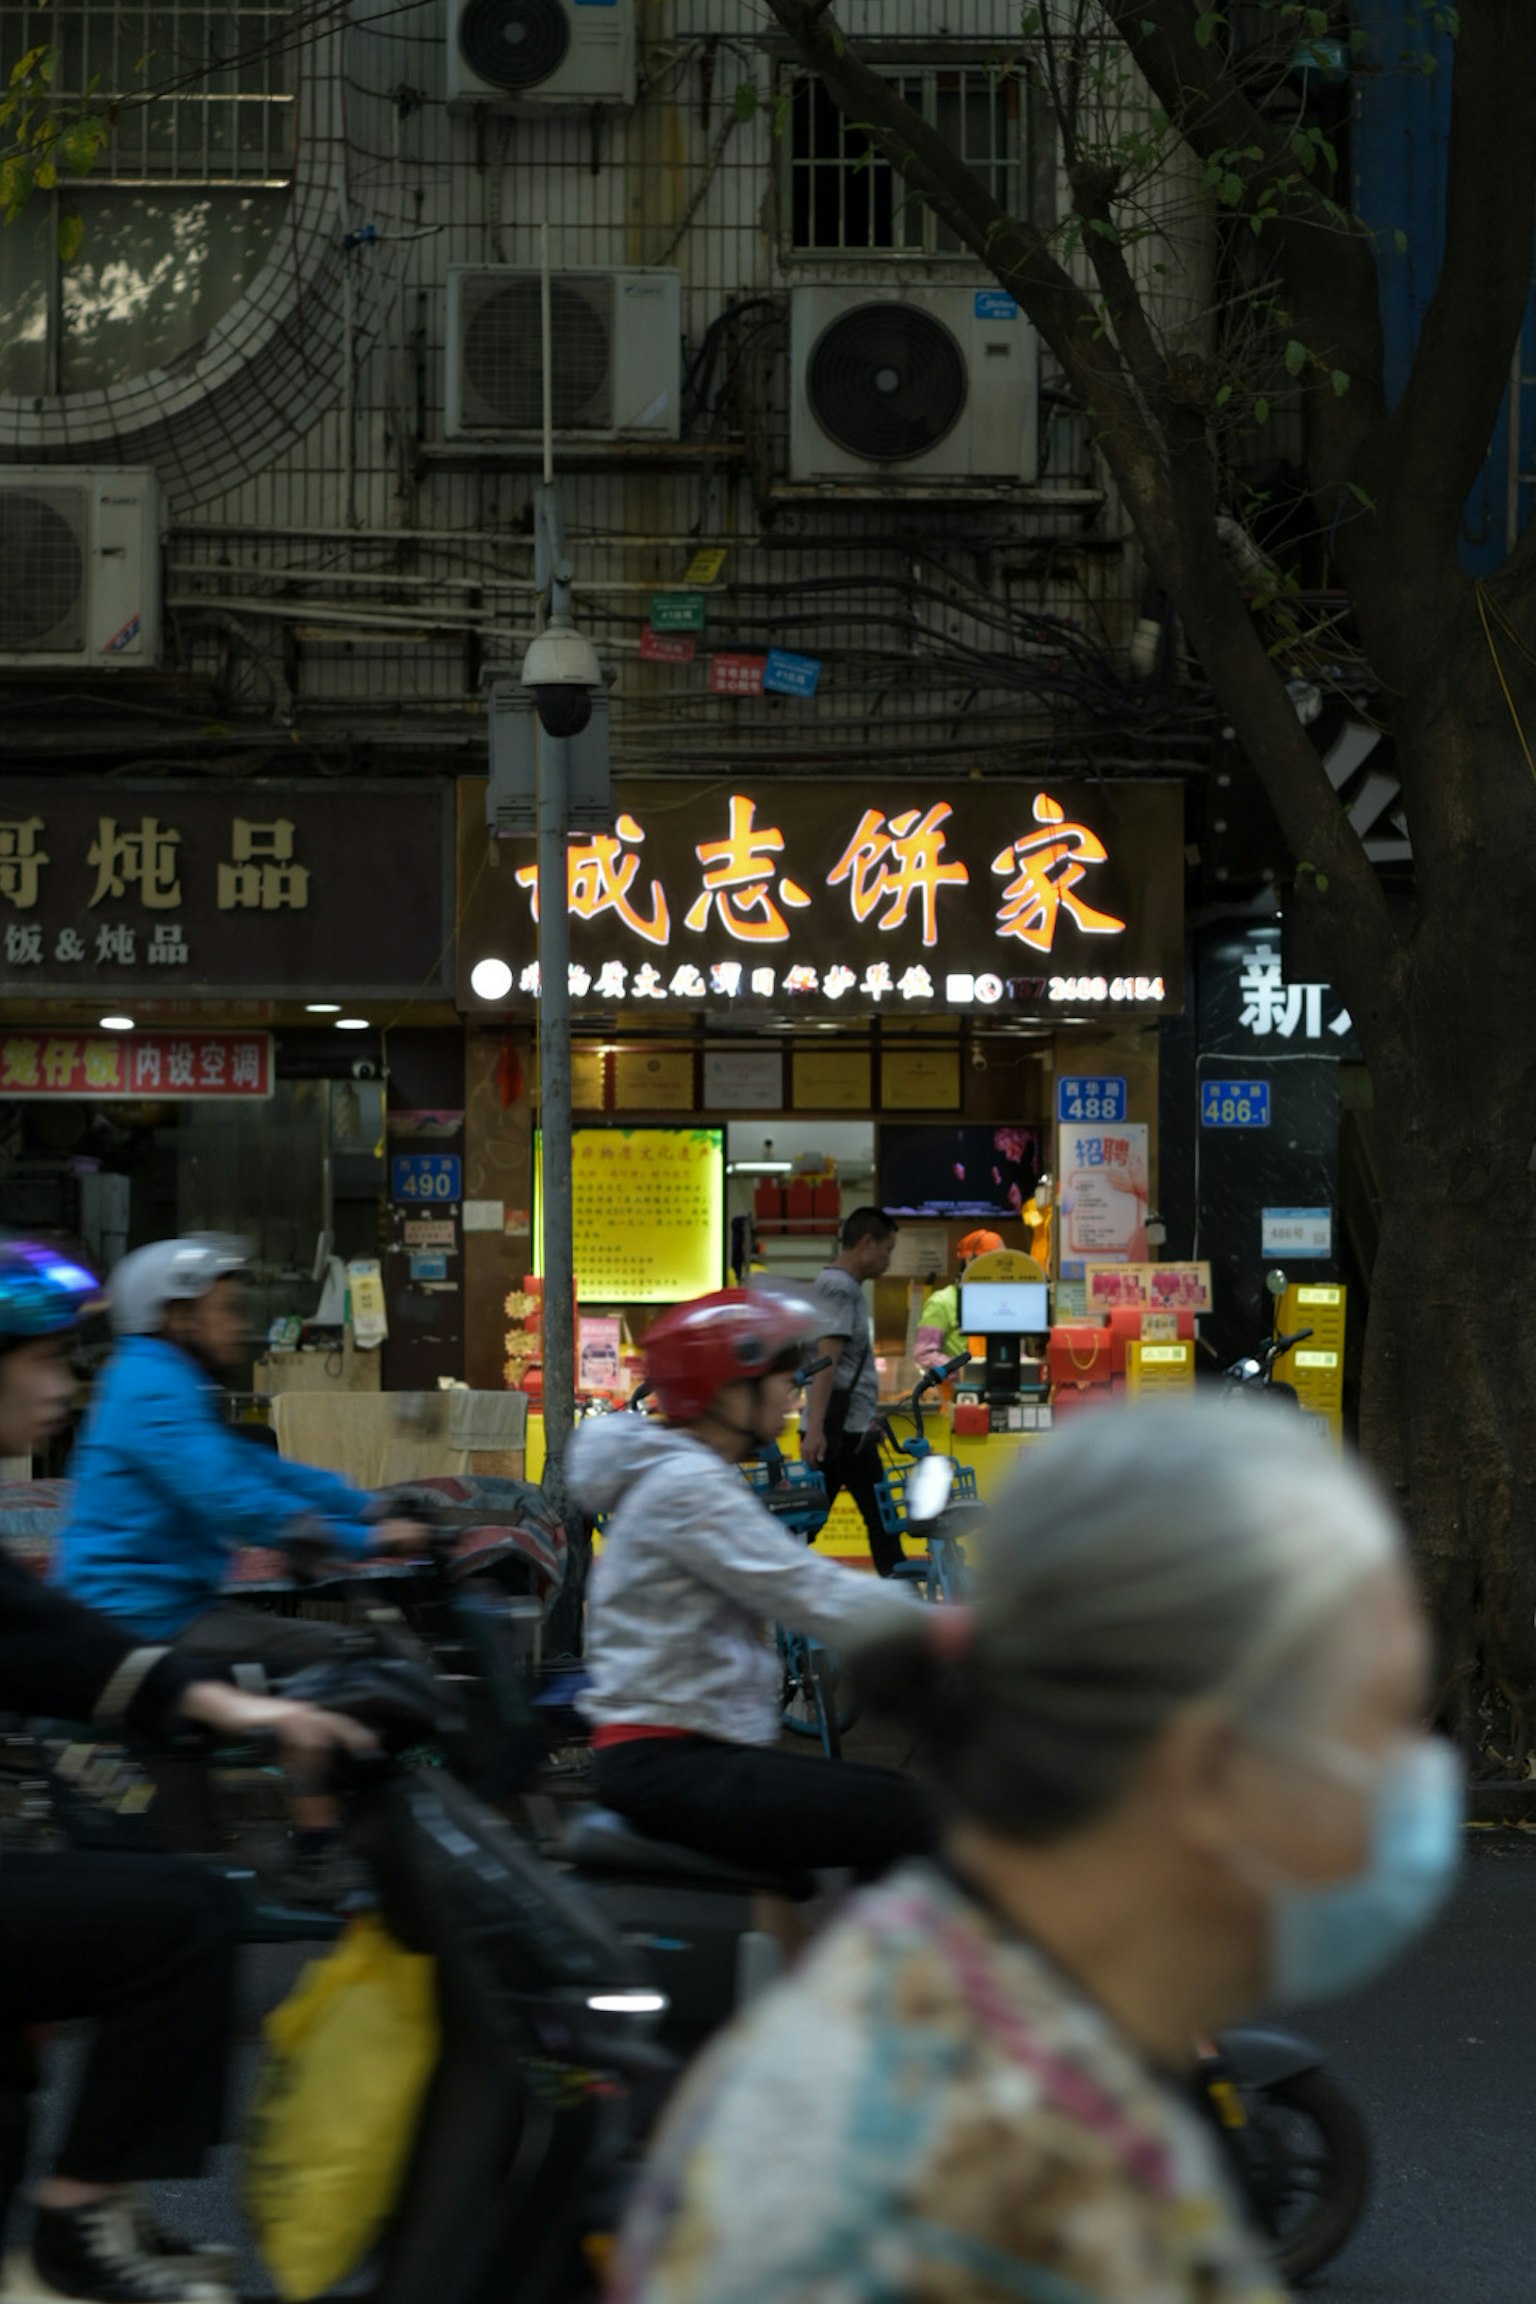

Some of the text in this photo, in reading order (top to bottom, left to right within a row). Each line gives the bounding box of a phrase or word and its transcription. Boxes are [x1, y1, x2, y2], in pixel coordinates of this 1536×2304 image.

[1238, 943, 1353, 1038] 新
[136, 1042, 261, 1089] 内设空调
[1068, 1097, 1117, 1119] 488
[1205, 1099, 1267, 1122] 486-1
[1076, 1136, 1130, 1168] 招聘
[403, 1172, 451, 1197] 490
